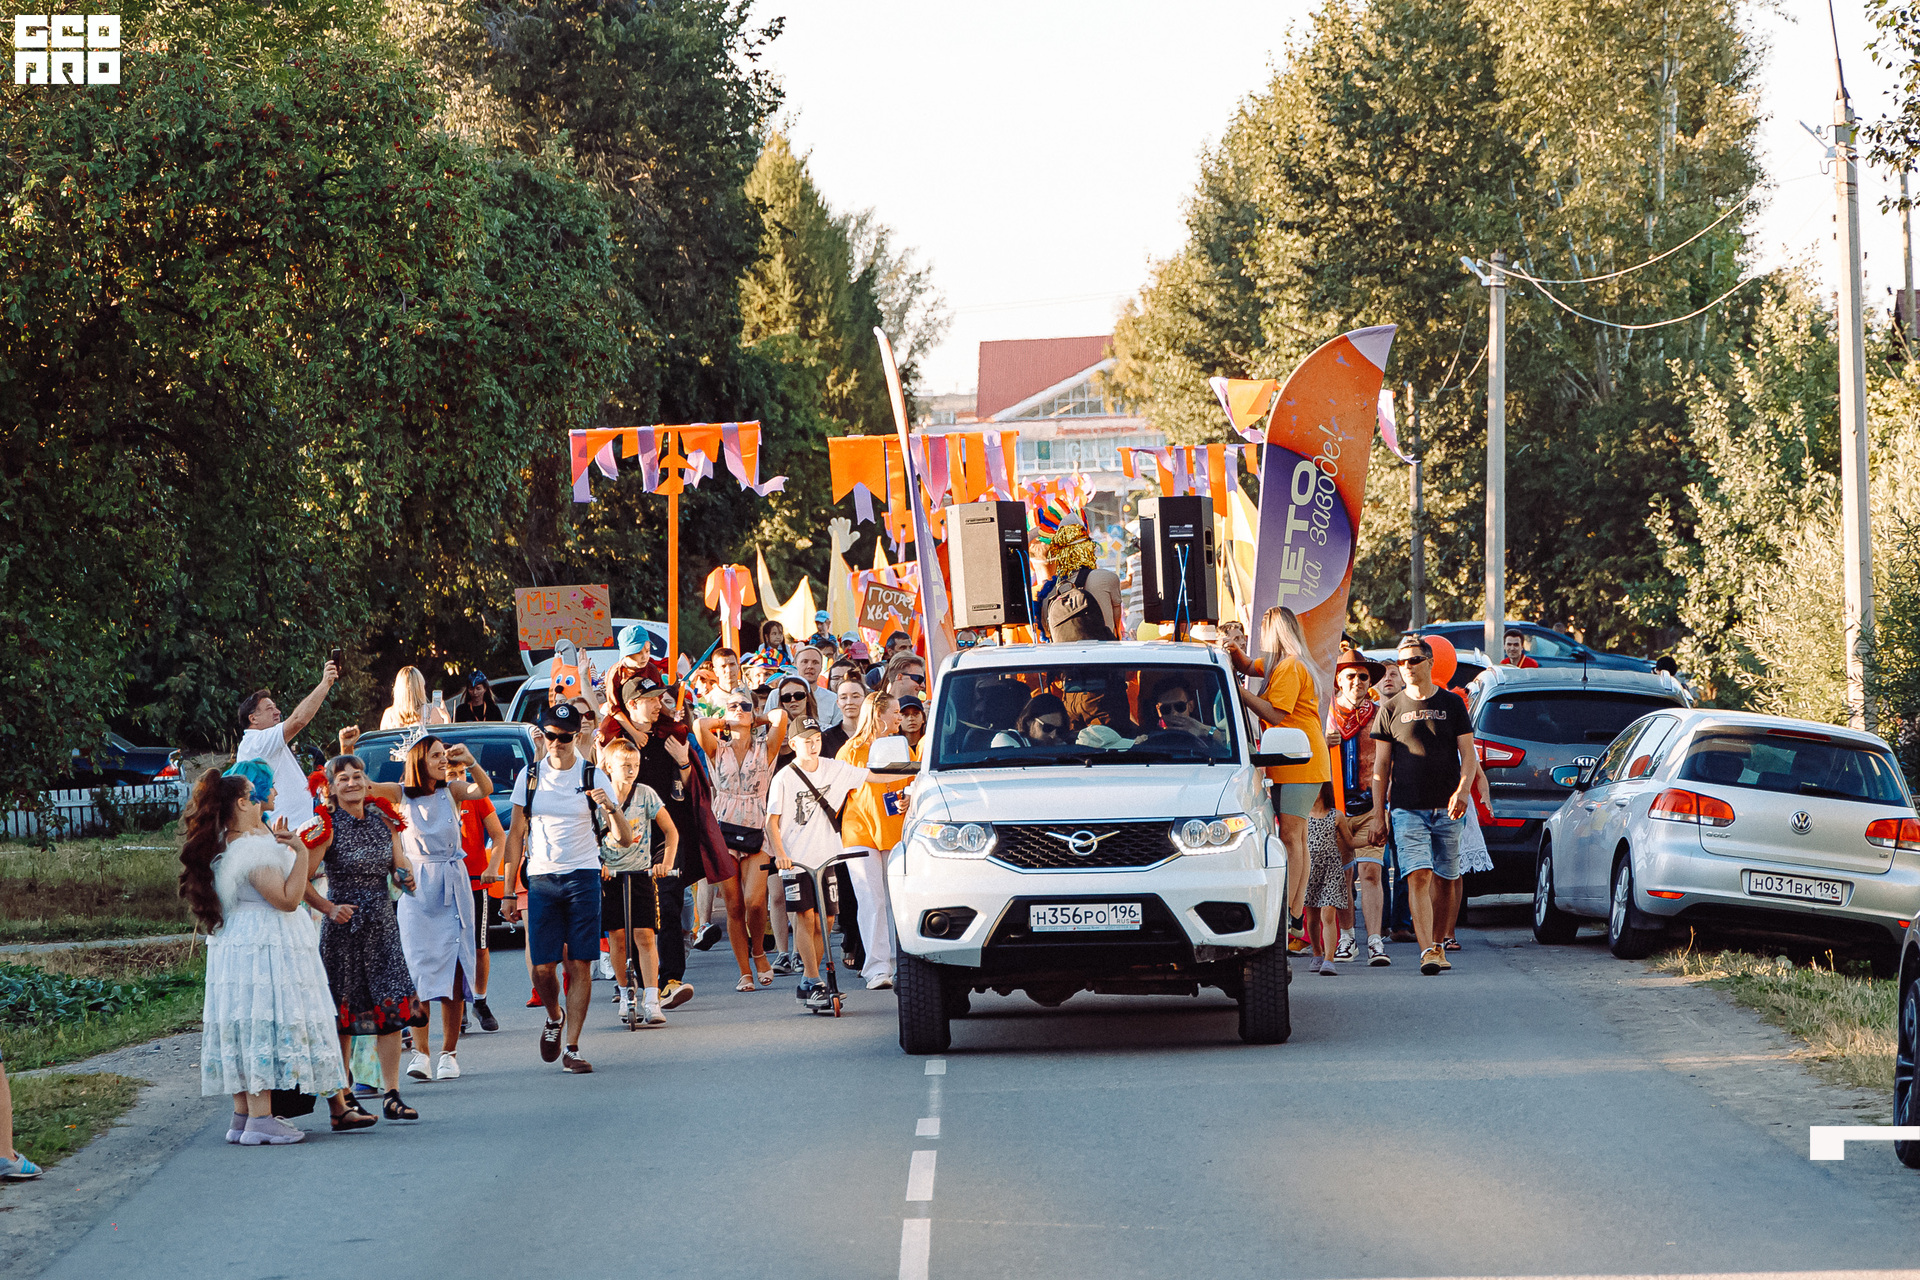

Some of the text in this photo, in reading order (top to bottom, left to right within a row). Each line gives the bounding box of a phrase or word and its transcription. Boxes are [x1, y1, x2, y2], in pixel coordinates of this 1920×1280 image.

[1301, 424, 1343, 598] на заводе!
[526, 592, 561, 612] МЫ
[1705, 831, 1731, 839] GOLF
[1755, 876, 1838, 896] Н031ВК 196
[1036, 905, 1137, 925] Н356РО 196
